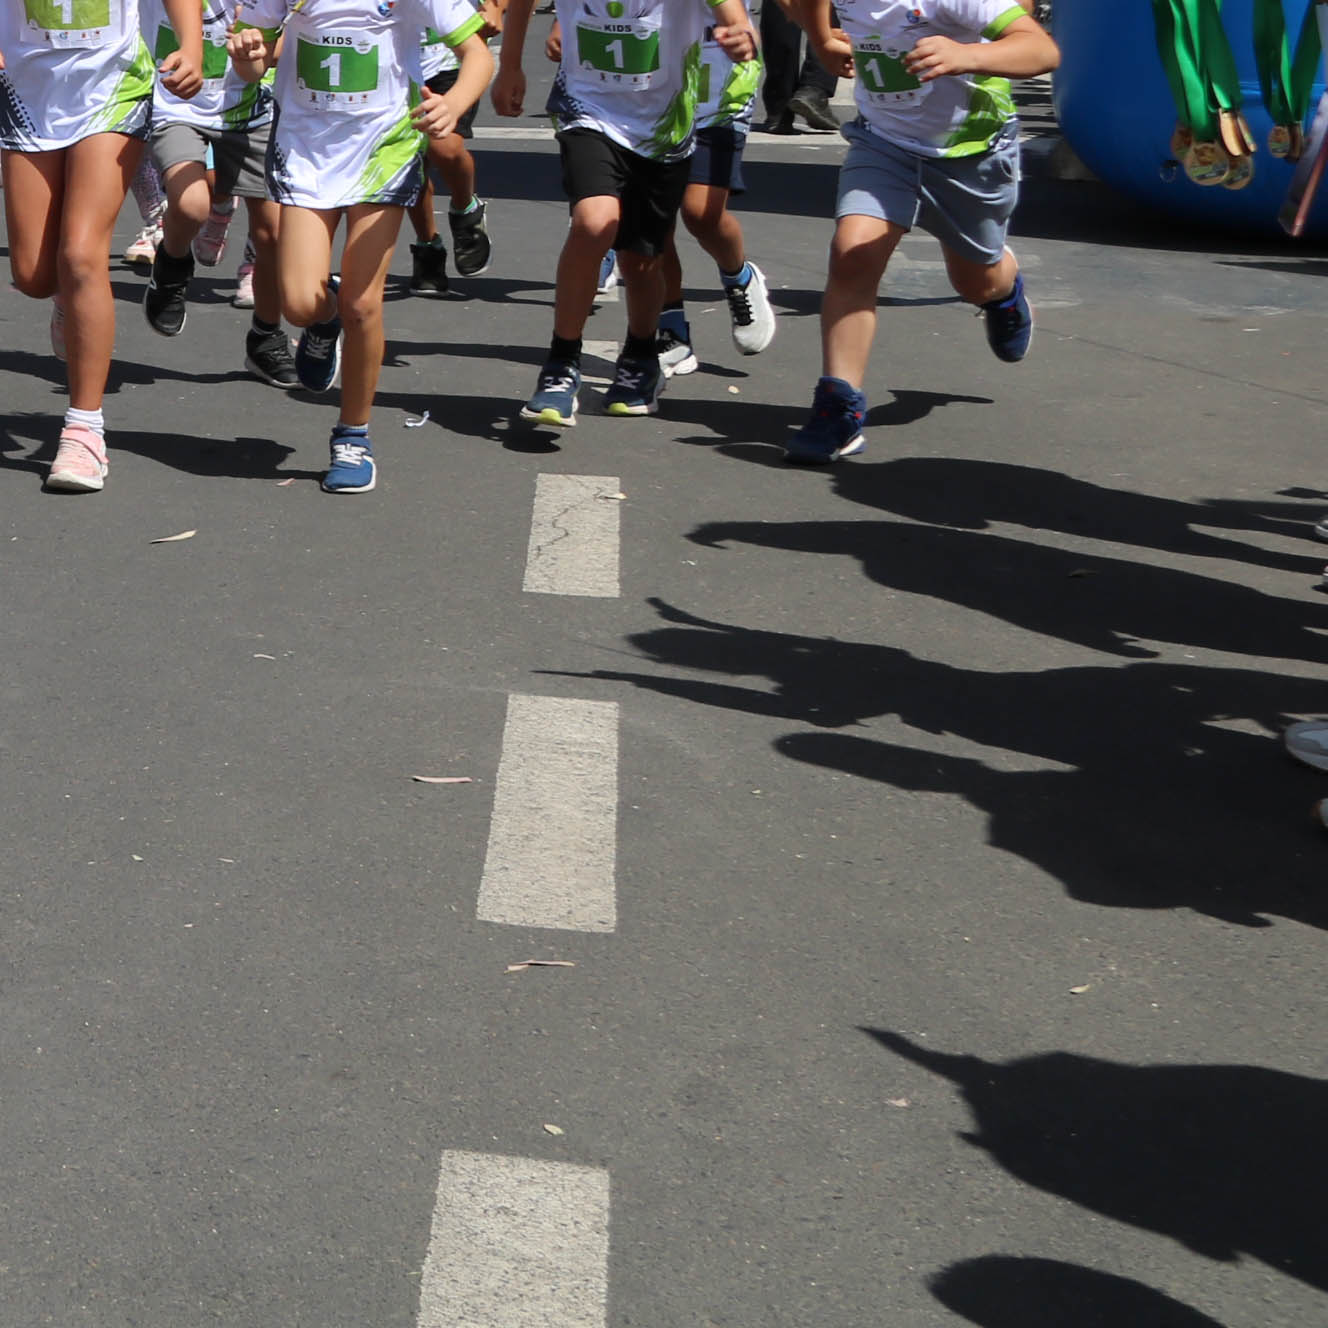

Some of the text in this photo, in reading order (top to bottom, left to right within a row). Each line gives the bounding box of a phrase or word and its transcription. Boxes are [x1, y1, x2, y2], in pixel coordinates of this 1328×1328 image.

[322, 36, 353, 45] KIDS
[604, 24, 632, 33] KIDS
[605, 40, 625, 68] 1
[320, 53, 341, 86] 1
[864, 58, 885, 88] 1
